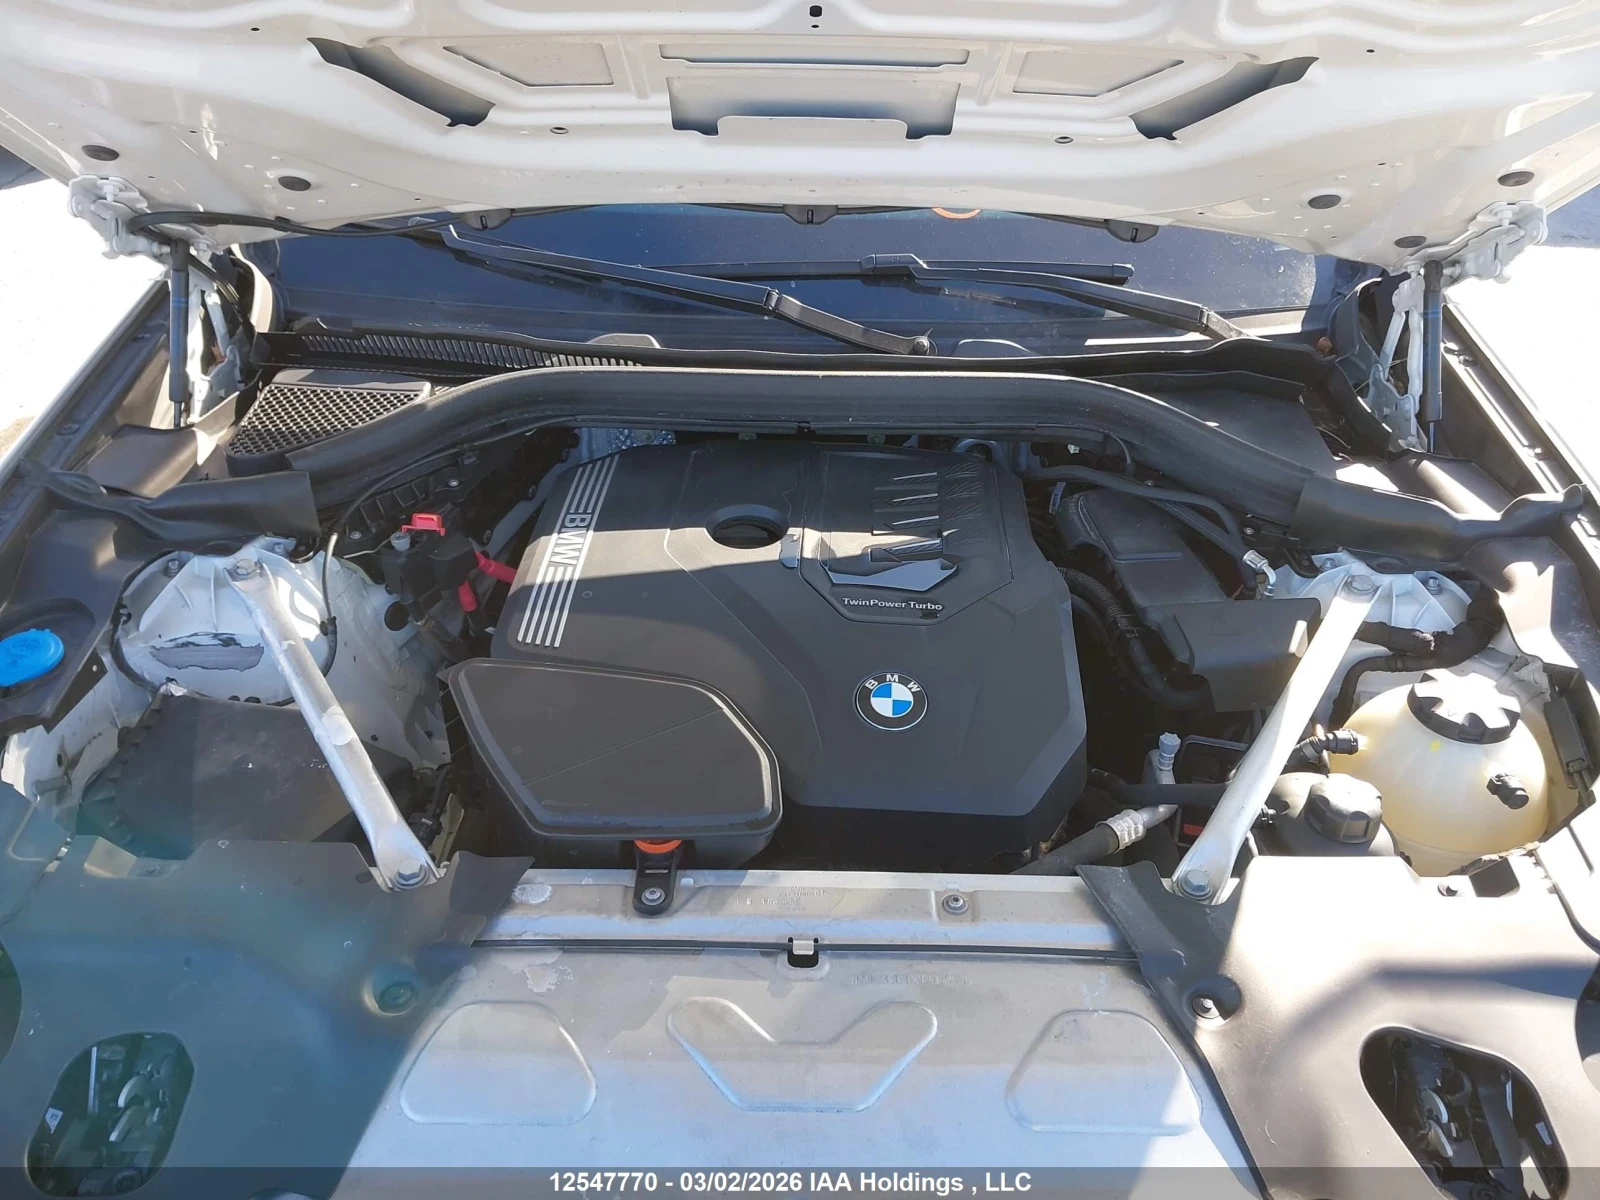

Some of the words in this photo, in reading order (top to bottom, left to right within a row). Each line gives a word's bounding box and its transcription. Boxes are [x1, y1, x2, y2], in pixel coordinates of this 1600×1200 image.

[549, 513, 592, 566] BMW
[908, 601, 943, 611] Turbo
[864, 674, 921, 693] BMW
